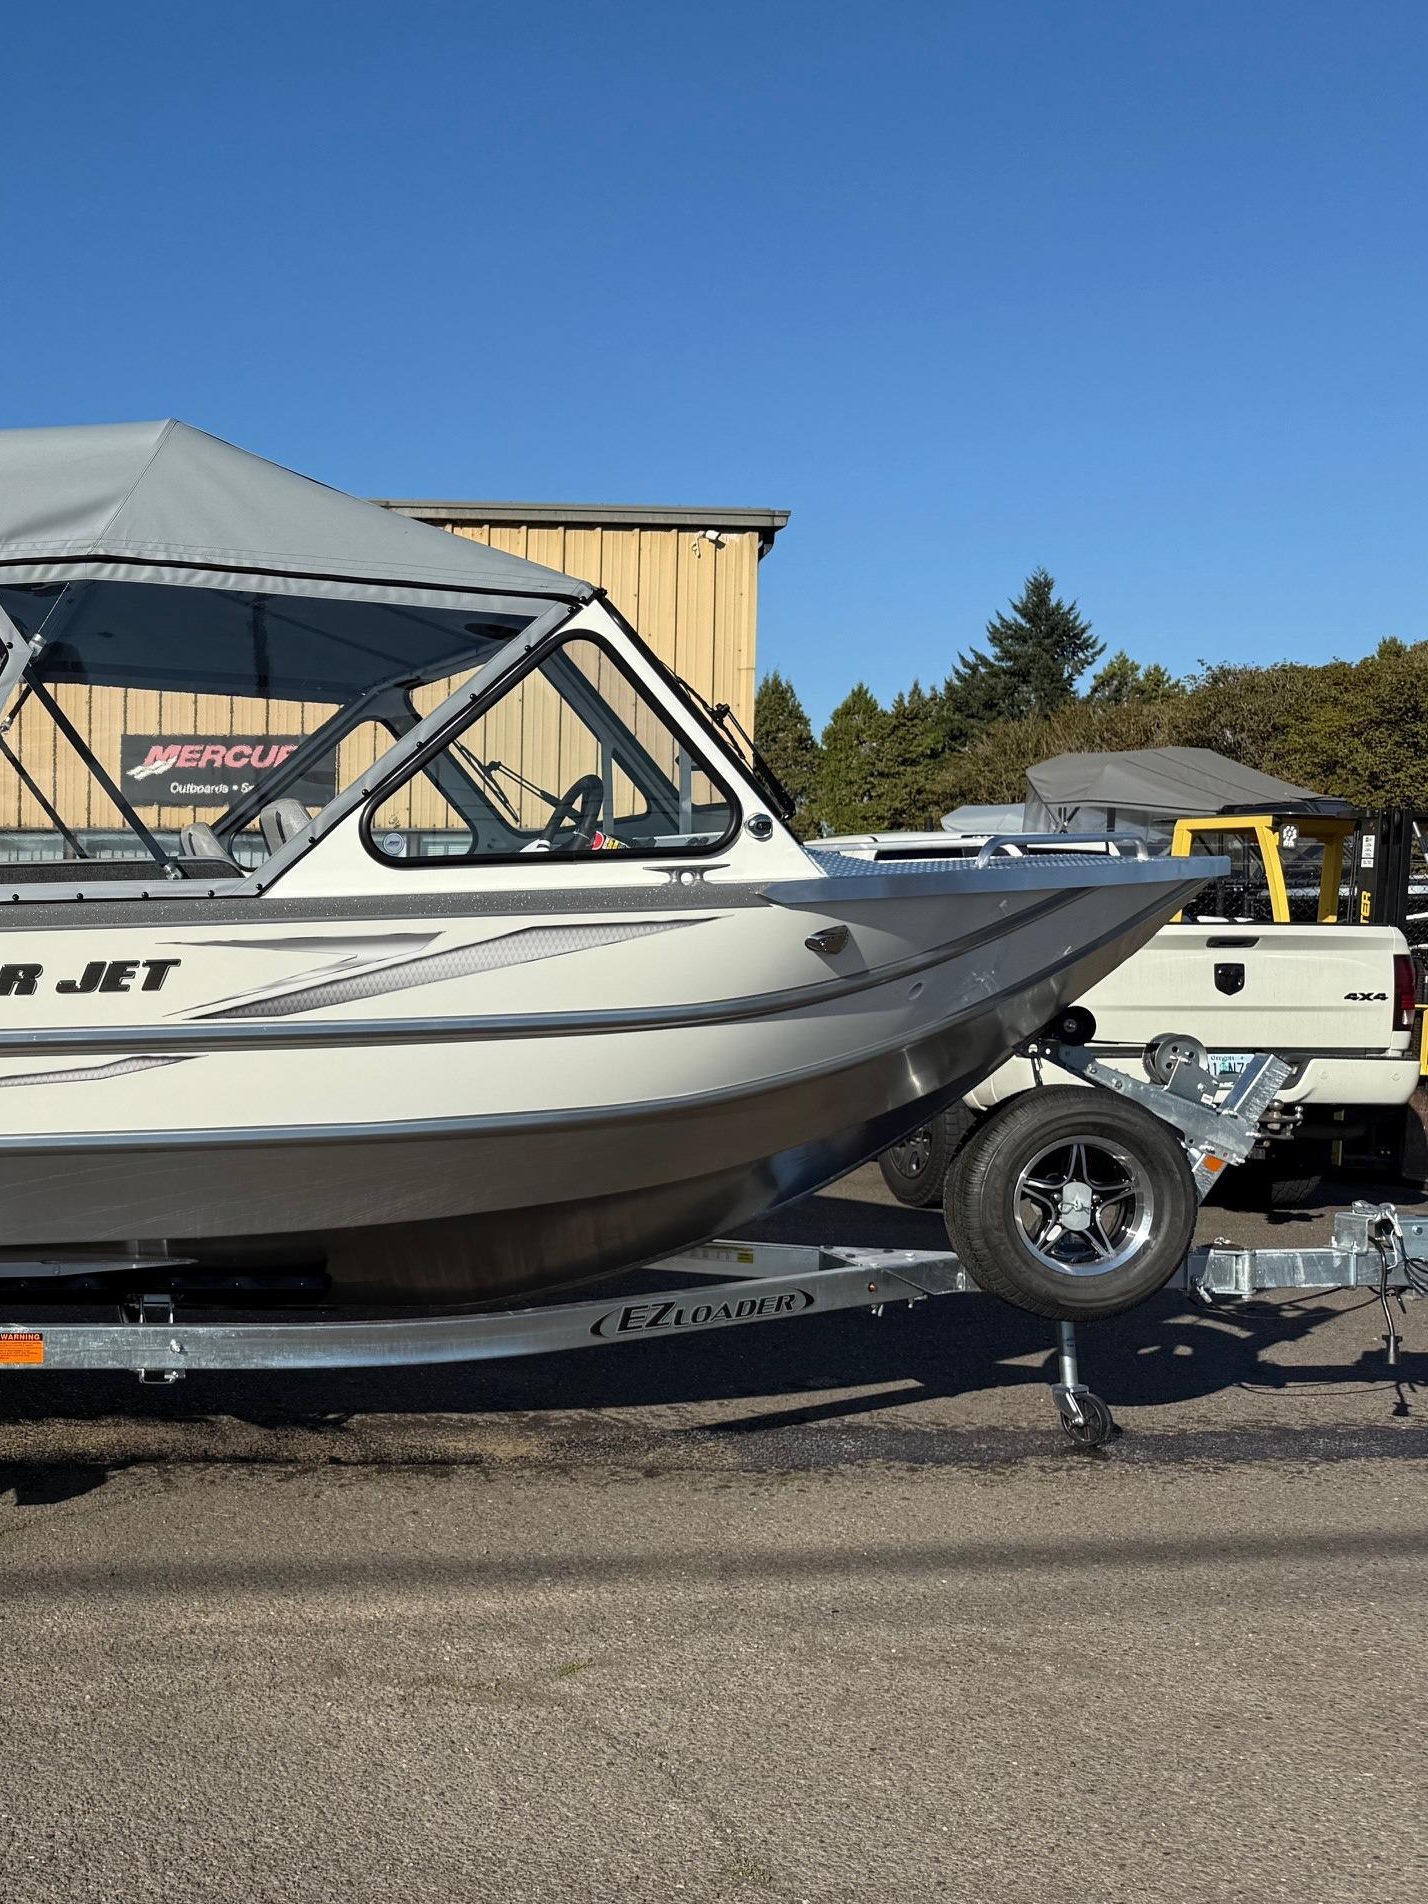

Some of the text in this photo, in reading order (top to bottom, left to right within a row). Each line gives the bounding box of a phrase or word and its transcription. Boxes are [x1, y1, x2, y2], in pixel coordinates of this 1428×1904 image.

[170, 781, 229, 794] Outboards
[55, 959, 181, 994] JET
[0, 1333, 40, 1341] WARNING
